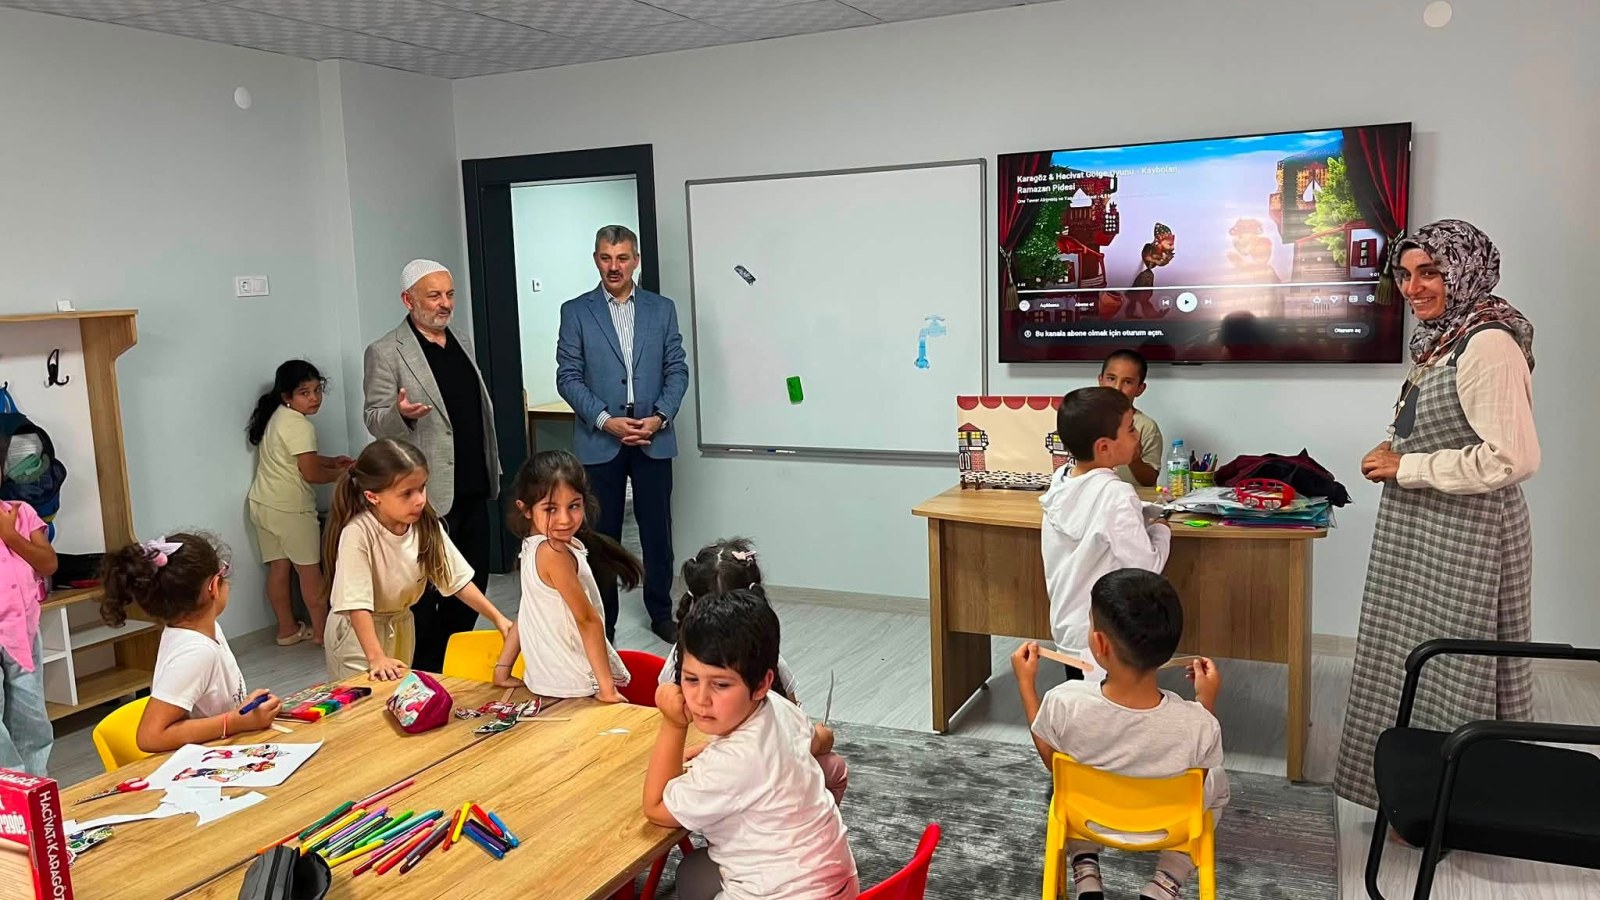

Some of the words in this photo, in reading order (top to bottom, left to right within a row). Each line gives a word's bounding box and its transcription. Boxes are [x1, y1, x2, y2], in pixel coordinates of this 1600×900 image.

[1017, 174, 1047, 183] Karagöz
[1056, 172, 1084, 180] Hacivat
[1110, 169, 1134, 177] Oyunu
[1141, 165, 1178, 175] Kaybolan
[1017, 186, 1051, 194] Ramazan
[1052, 183, 1076, 191] Pidesi
[1109, 329, 1121, 337] için
